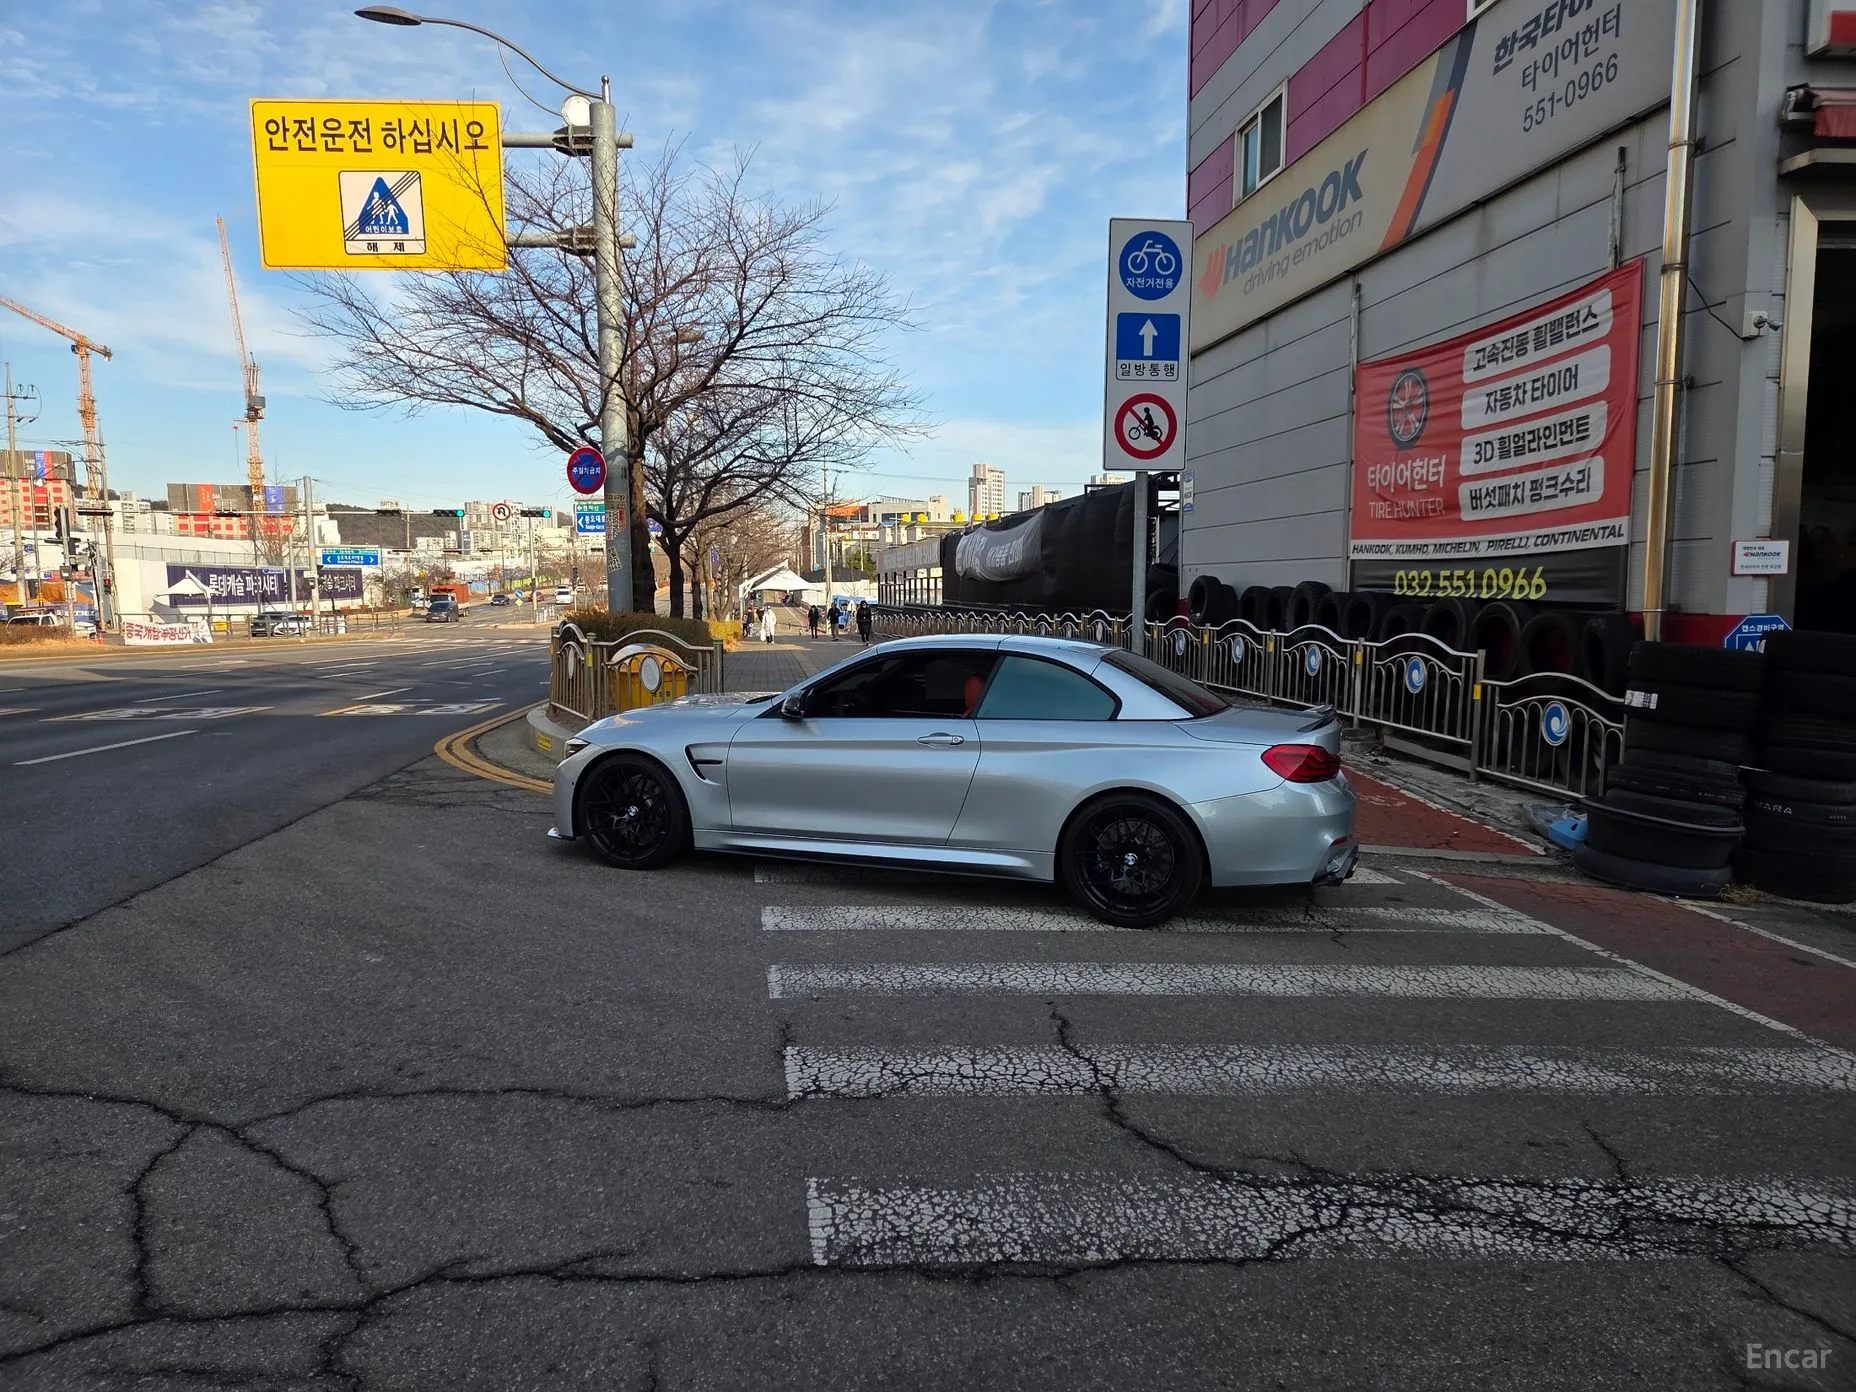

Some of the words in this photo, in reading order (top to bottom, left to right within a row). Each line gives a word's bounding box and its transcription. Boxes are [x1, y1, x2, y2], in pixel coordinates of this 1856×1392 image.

[1521, 3, 1621, 93] 타이어헌터
[1523, 53, 1619, 133] 551-0966
[265, 116, 373, 152] 안전운전
[381, 117, 489, 154] 하십시오
[365, 224, 404, 234] 어린이보호
[1244, 253, 1290, 296] driving
[1292, 210, 1362, 267] emotion
[1126, 277, 1174, 289] 자전거전용
[1473, 331, 1528, 373] 고속진동
[1533, 305, 1600, 352] 휠밸런스
[1120, 363, 1175, 377] 일방통행
[1484, 385, 1527, 416] 자동차
[1531, 364, 1579, 403] 타이어
[1473, 439, 1495, 465] 3D
[1498, 413, 1591, 460] 휠얼라인먼트
[1367, 454, 1447, 493] 타이어헌터
[1469, 478, 1526, 512] 버섯패치
[1529, 466, 1591, 504] 펑크수리
[1369, 501, 1393, 519] TIRE
[1394, 497, 1445, 517] HUNTER
[1351, 543, 1394, 556] HANKOOK,
[1394, 542, 1430, 555] KUMHO,
[1533, 523, 1625, 548] CONTINENTAL
[1394, 566, 1547, 600] 032.551.0966
